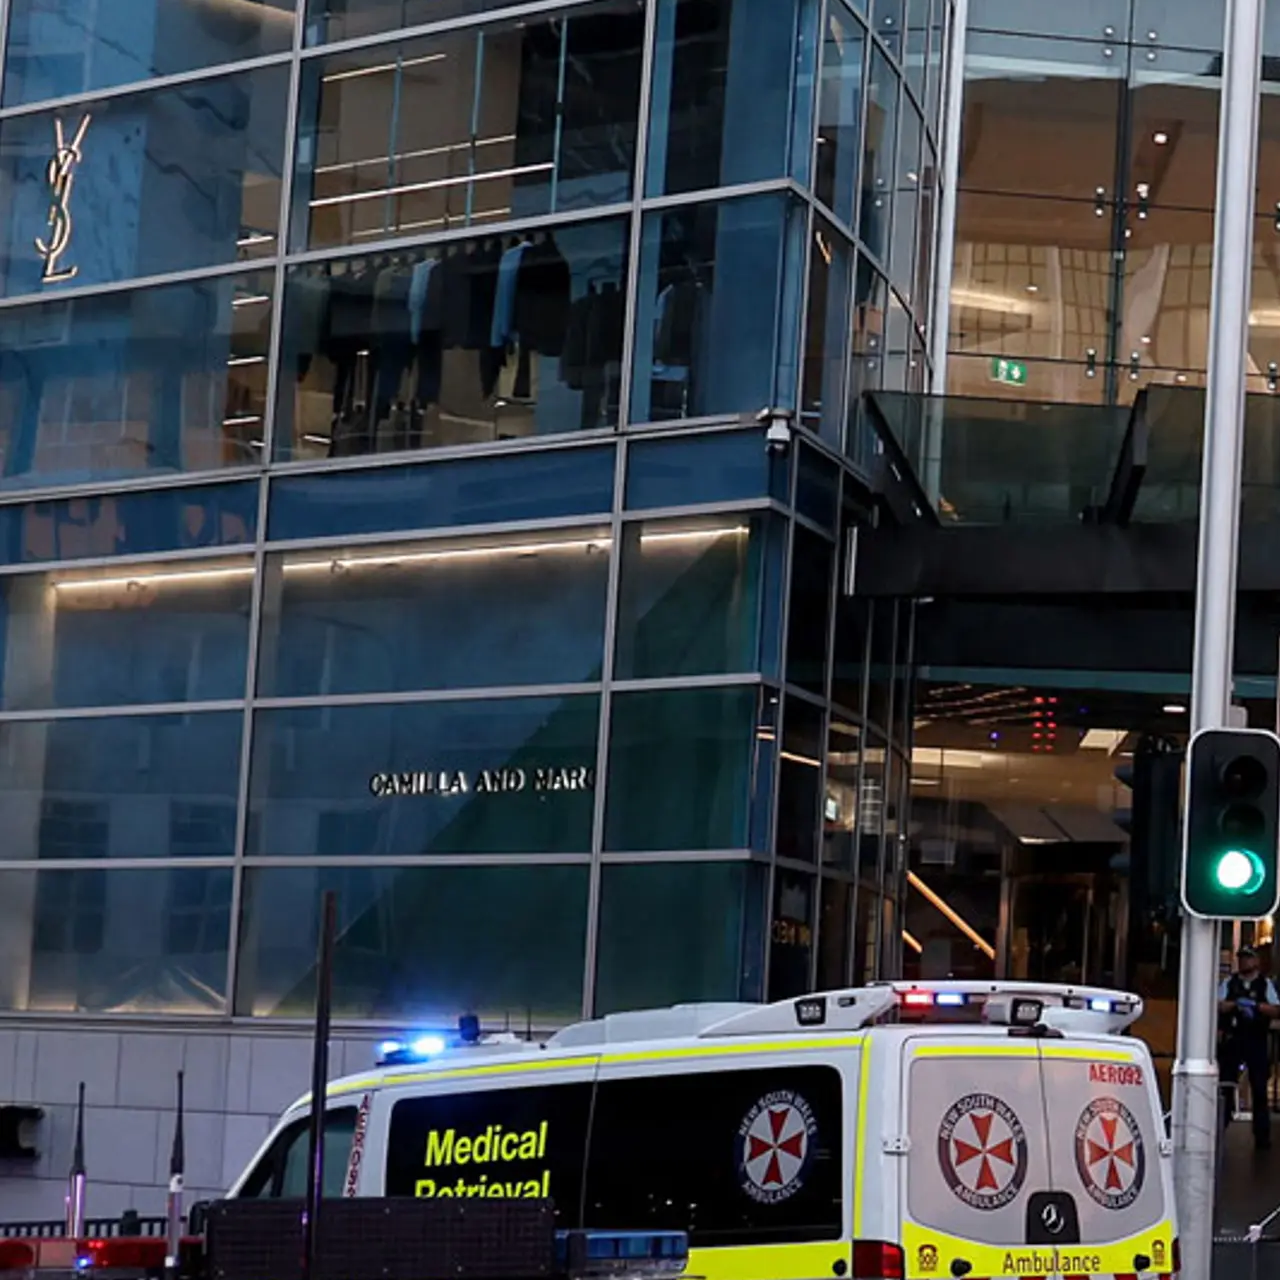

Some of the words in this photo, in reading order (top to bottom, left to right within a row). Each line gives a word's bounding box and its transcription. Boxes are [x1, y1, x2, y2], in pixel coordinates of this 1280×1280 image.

[475, 767, 527, 793] AND
[424, 1120, 549, 1167] Medical
[1002, 1251, 1101, 1274] Ambulance
